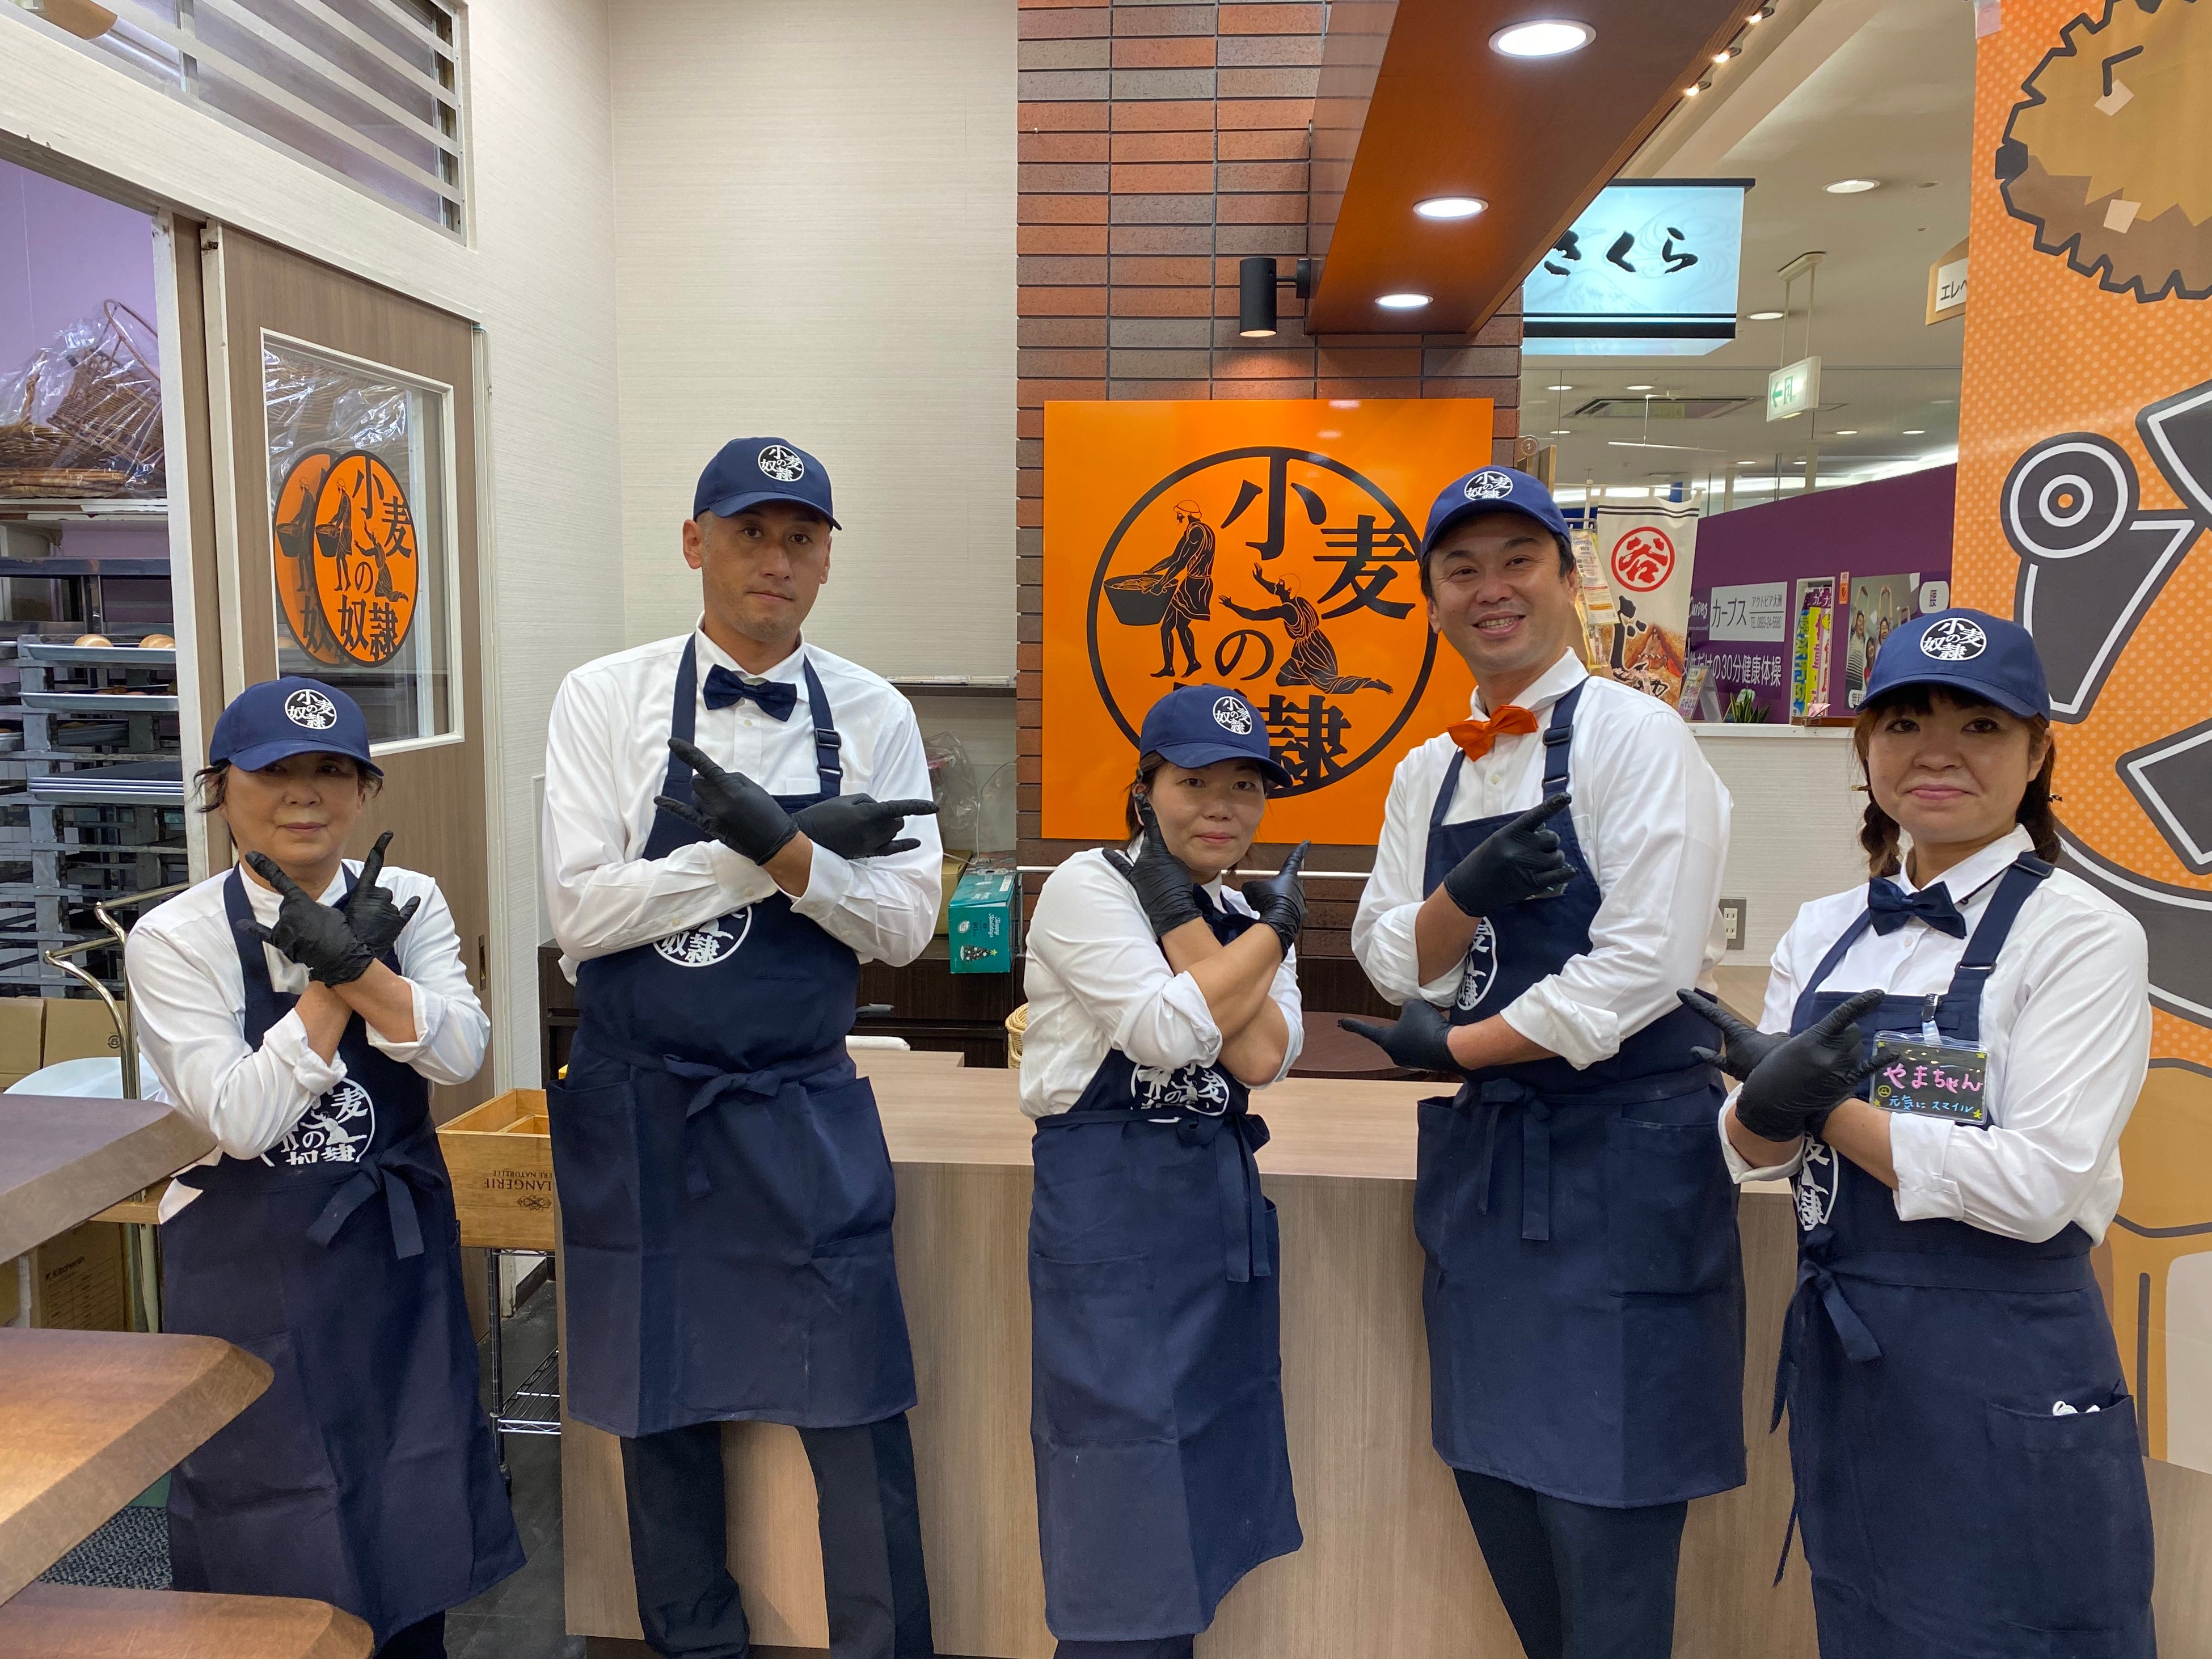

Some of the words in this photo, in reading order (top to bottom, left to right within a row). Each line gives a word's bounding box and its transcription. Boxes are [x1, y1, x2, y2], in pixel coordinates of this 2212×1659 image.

[1711, 598, 1747, 628] カーブス
[1883, 1063, 1984, 1094] やまちゃん
[1889, 1095, 1926, 1111] 元気に
[1932, 1101, 1974, 1113] スマイル
